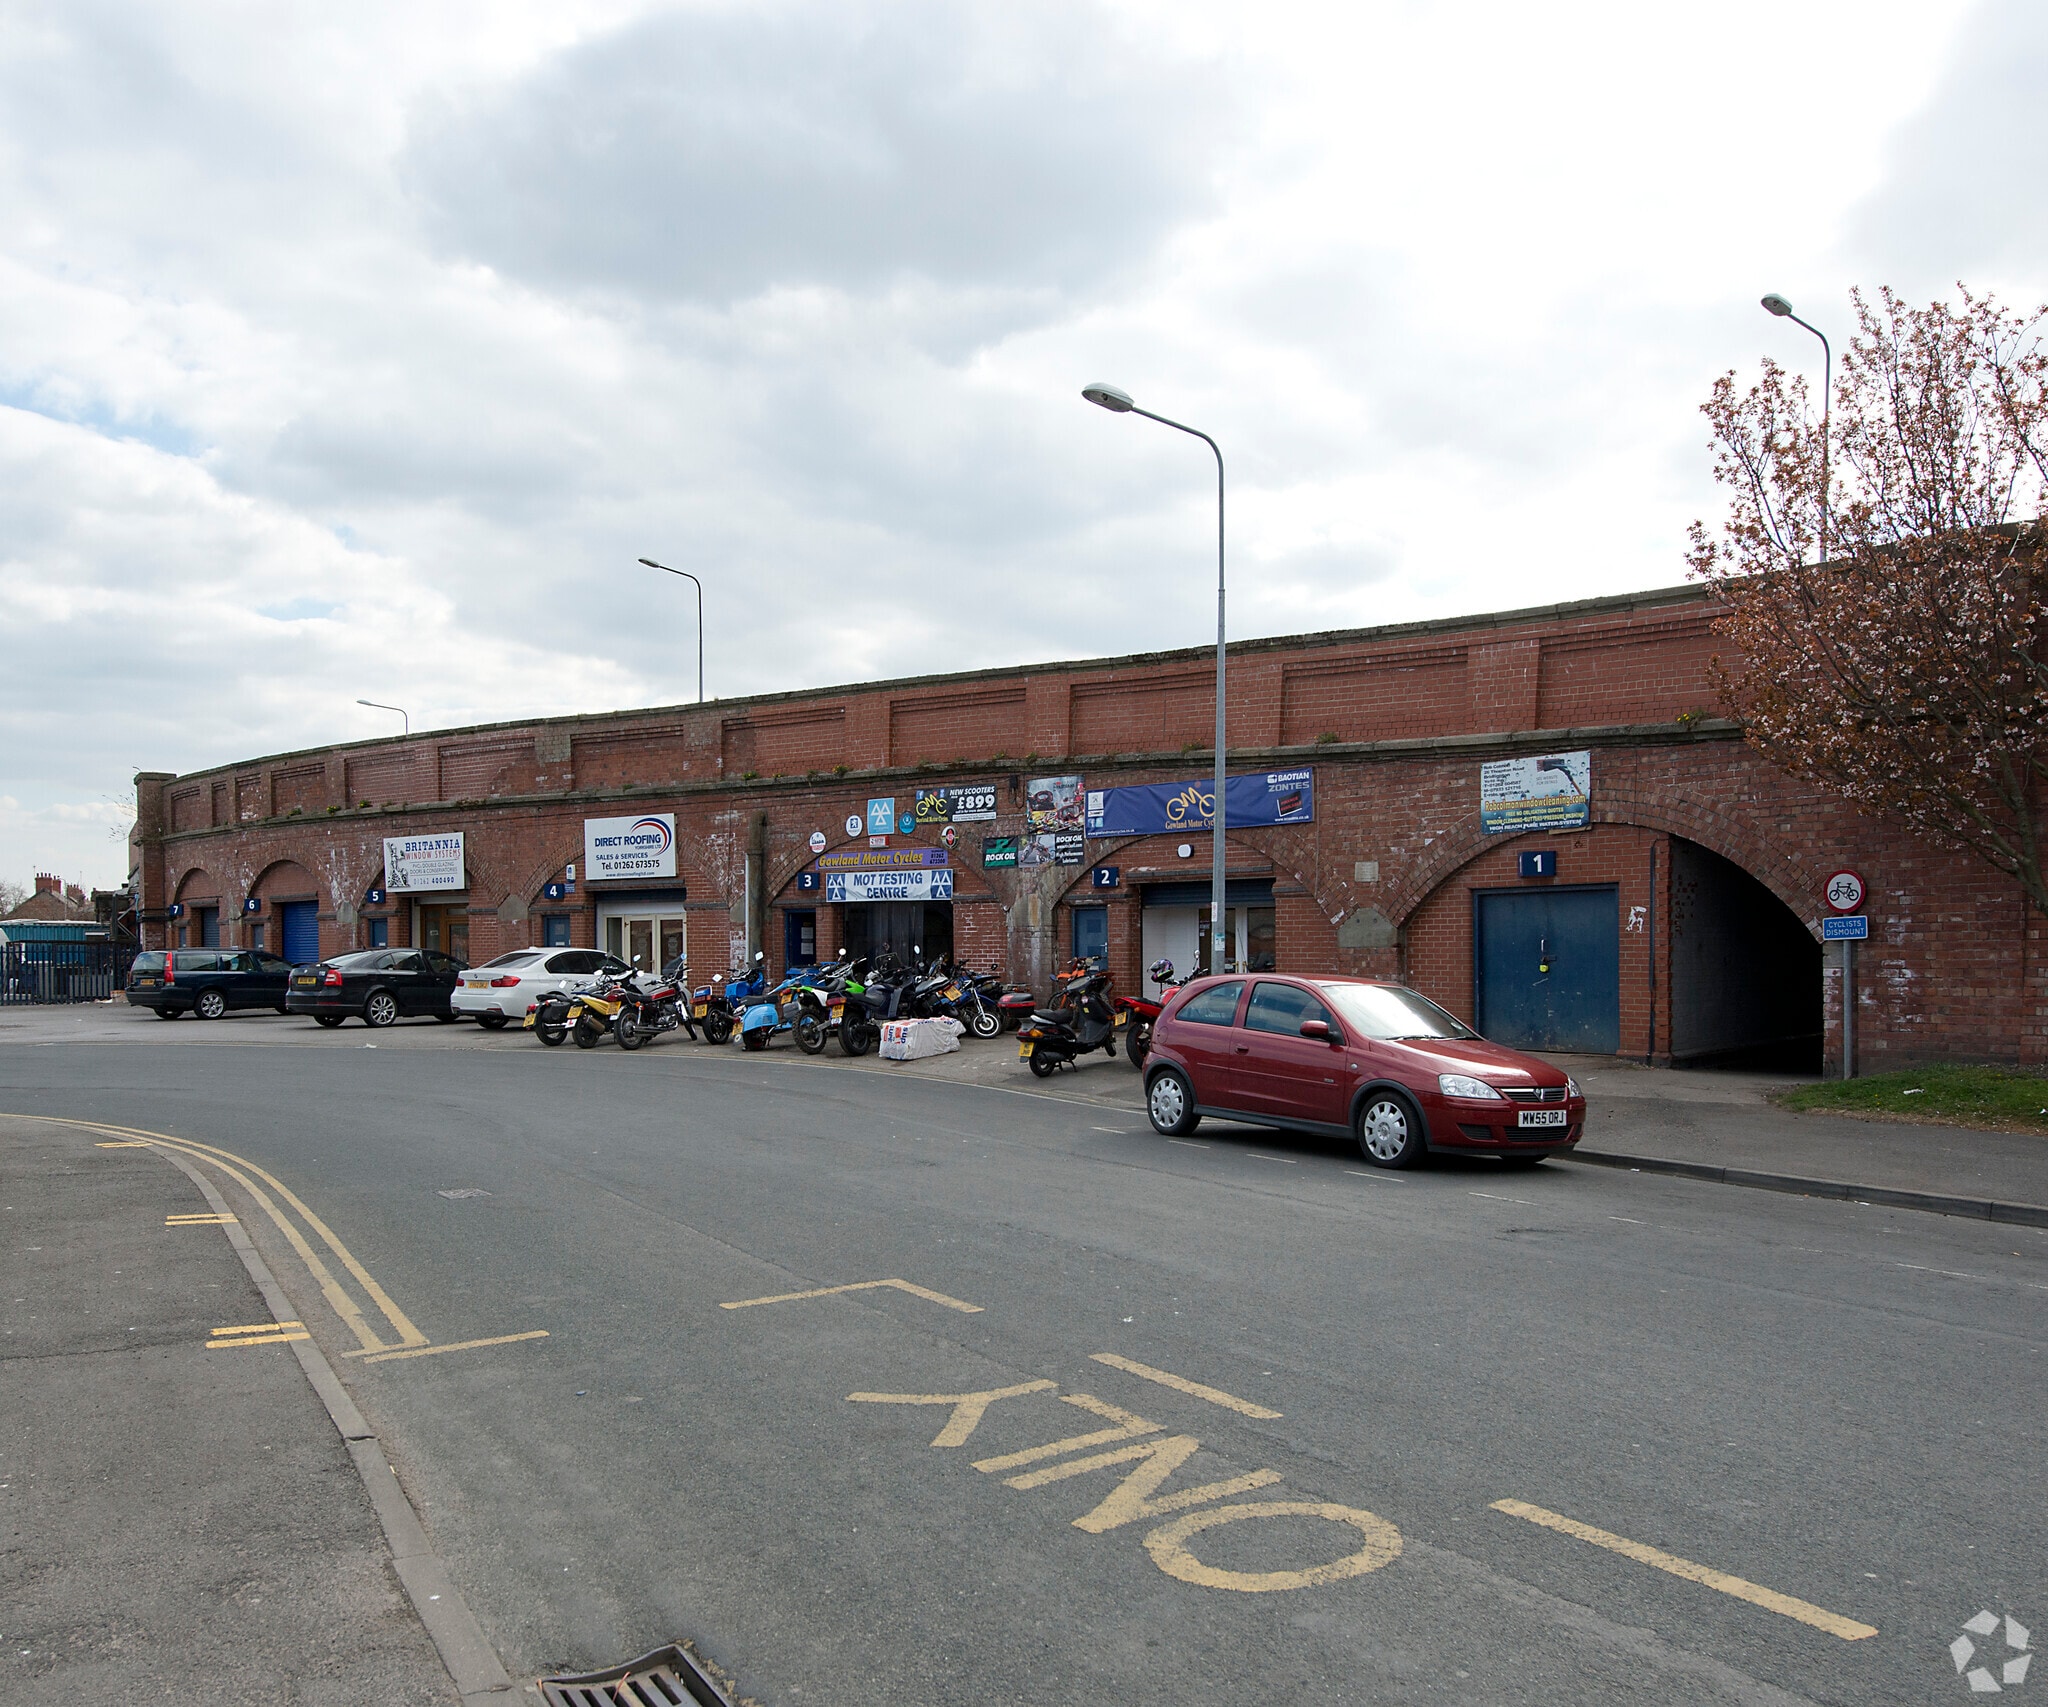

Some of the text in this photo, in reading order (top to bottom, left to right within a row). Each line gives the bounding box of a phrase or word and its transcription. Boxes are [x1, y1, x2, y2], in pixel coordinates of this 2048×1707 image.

[1278, 772, 1309, 782] BAOTIAN
[949, 786, 995, 796] NEW SCOOTERS
[1268, 781, 1309, 792] ZONTES
[957, 794, 995, 810] £899
[1165, 820, 1187, 830] Gowland
[405, 839, 461, 852] BRITANNIA
[594, 834, 661, 847] DIRECT ROOFING
[405, 849, 461, 860] WINDOW SYSTEMS
[621, 852, 648, 860] SERVICES
[818, 851, 923, 867] Gowland Motor Cycles
[986, 853, 1004, 861] ROCK
[602, 860, 660, 870] Tel. 01262 673575
[1533, 854, 1542, 873] 1
[804, 875, 812, 887] 3
[853, 872, 923, 886] MOT TESTING
[1101, 870, 1110, 884] 2
[372, 891, 379, 901] 5
[550, 885, 557, 897] 4
[867, 886, 908, 899] CENTRE
[173, 905, 178, 915] 7
[249, 899, 255, 910] 6
[1828, 920, 1862, 929] CYCLISTS
[1826, 927, 1865, 936] DISMOUNT
[1522, 1111, 1564, 1125] MW55 ORJ
[846, 1379, 1403, 1593] ONLY
